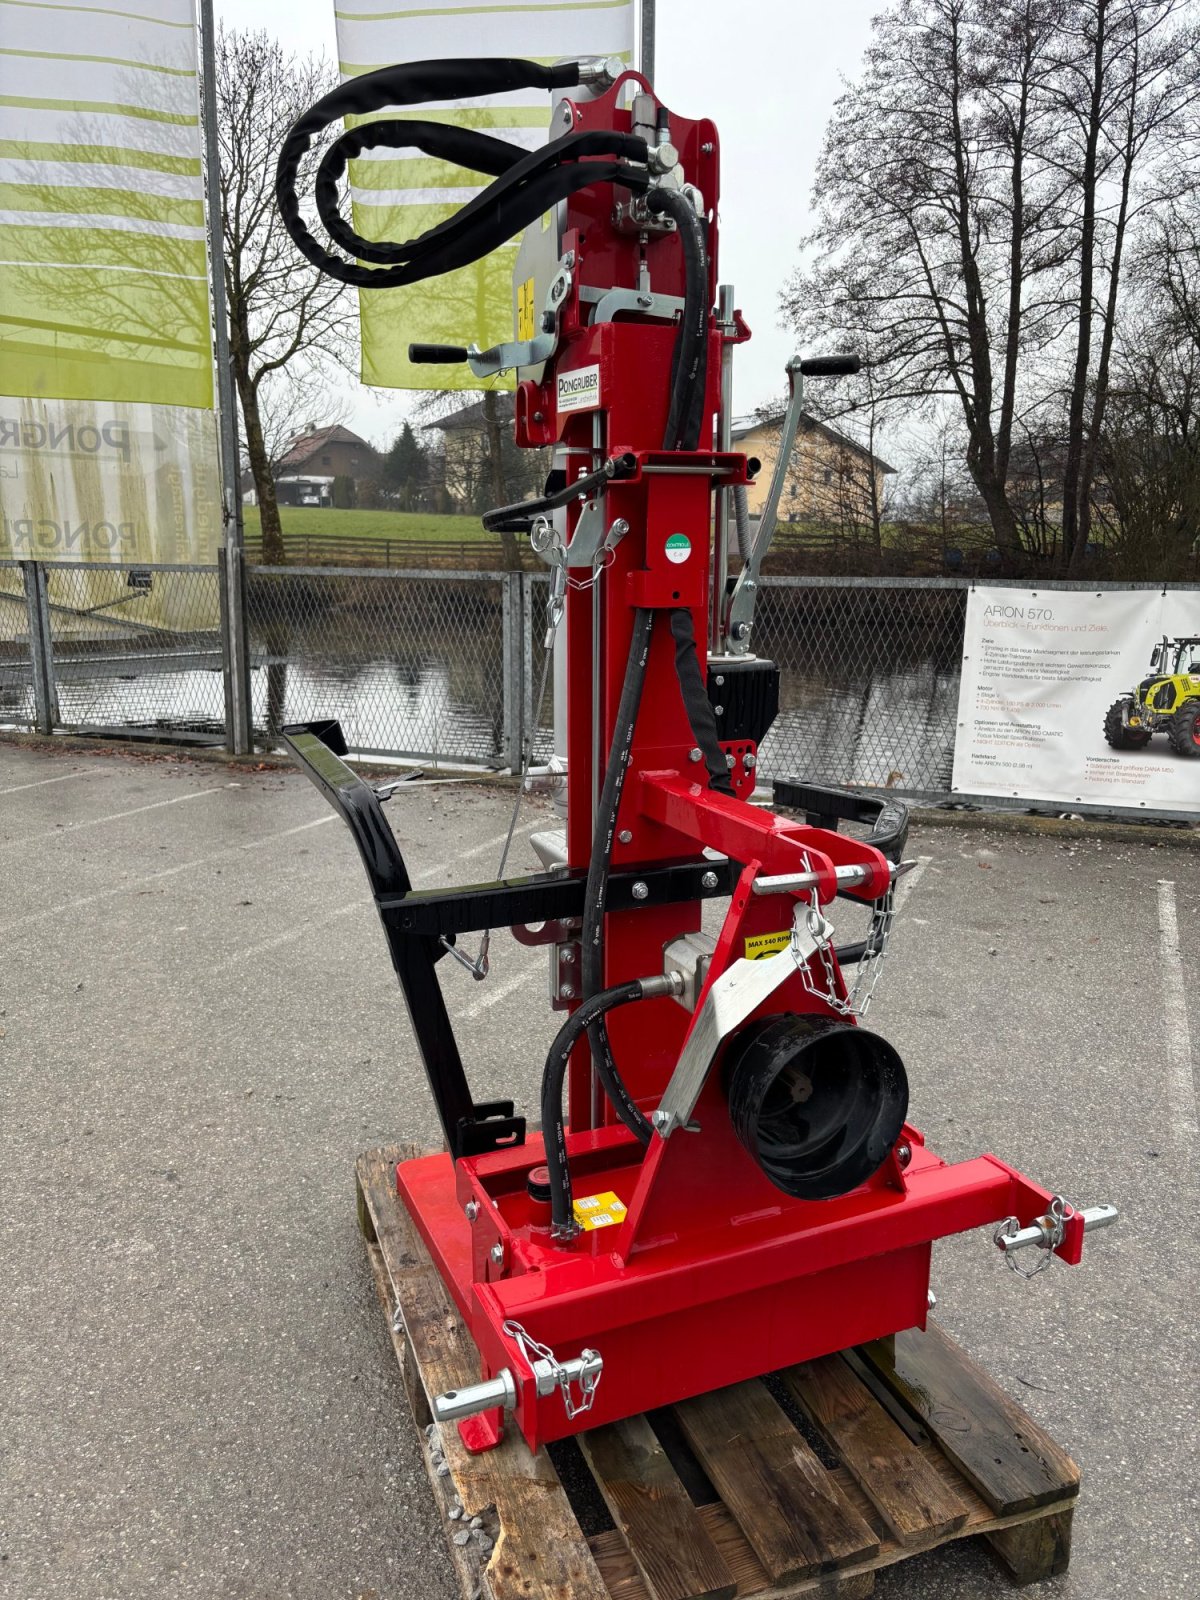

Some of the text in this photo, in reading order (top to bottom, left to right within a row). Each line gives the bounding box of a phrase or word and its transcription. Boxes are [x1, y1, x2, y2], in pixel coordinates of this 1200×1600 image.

[559, 374, 598, 398] PONGRUBER
[984, 606, 1055, 620] ARION 570.
[983, 620, 1018, 628] Überblick
[1026, 622, 1068, 632] Funktionen
[764, 938, 776, 946] 540
